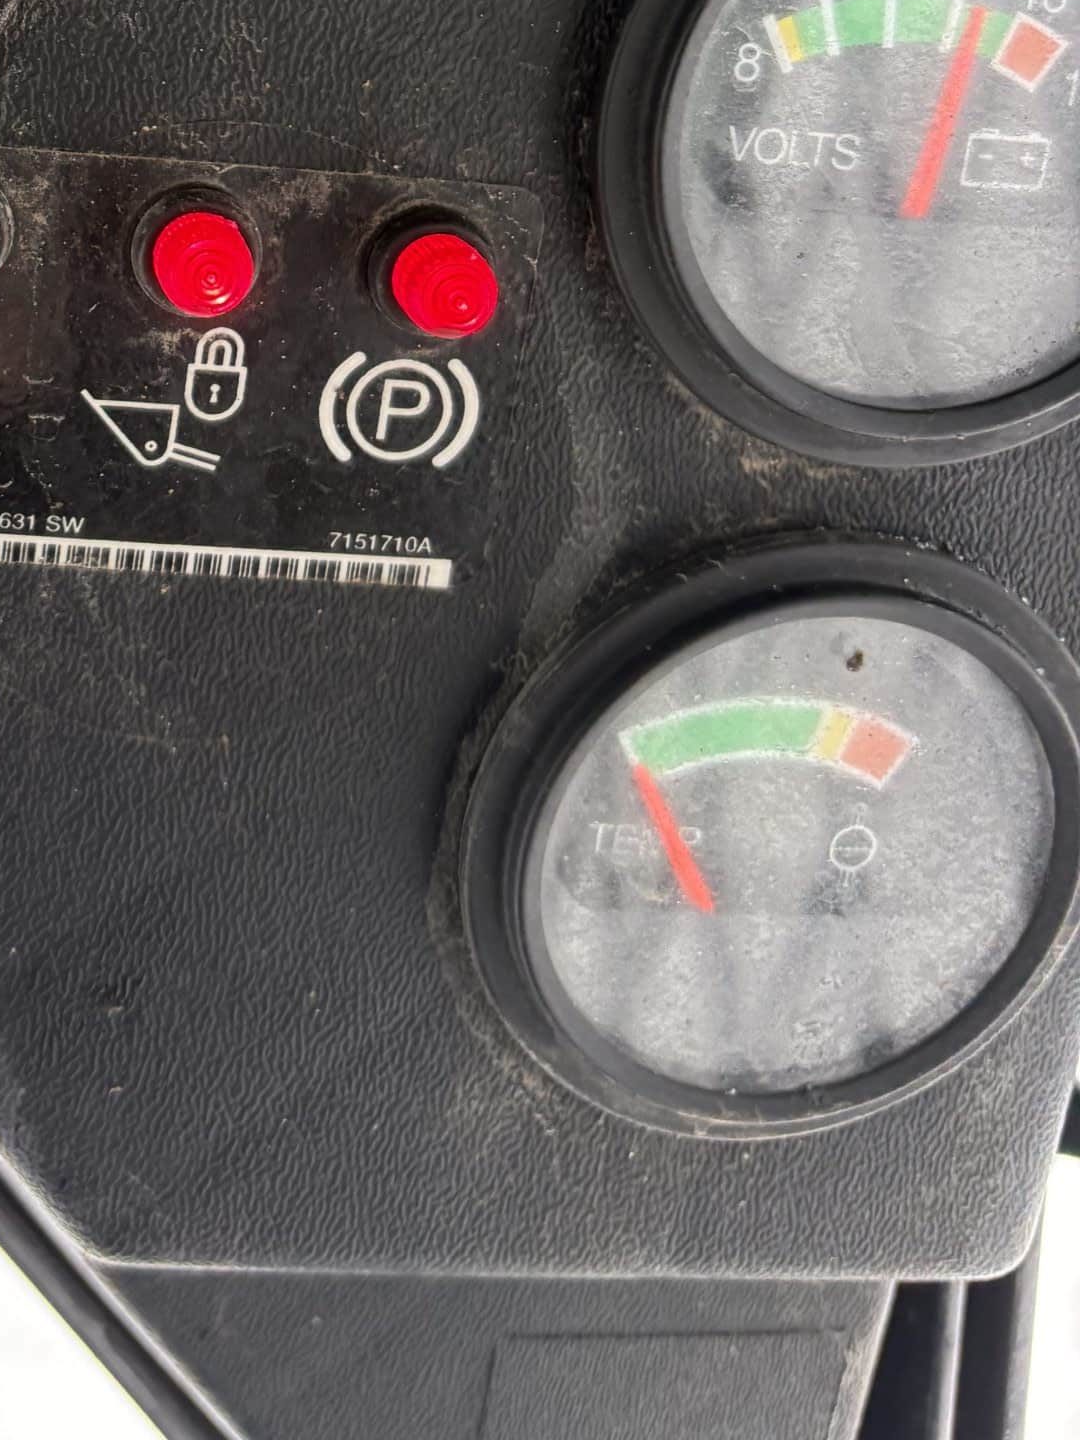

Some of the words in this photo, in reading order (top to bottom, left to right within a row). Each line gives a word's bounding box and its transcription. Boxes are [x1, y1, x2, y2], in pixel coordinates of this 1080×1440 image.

[734, 42, 762, 83] 8
[728, 125, 861, 171] VOLTS
[45, 514, 86, 534] SW
[328, 531, 432, 554] 7151710A
